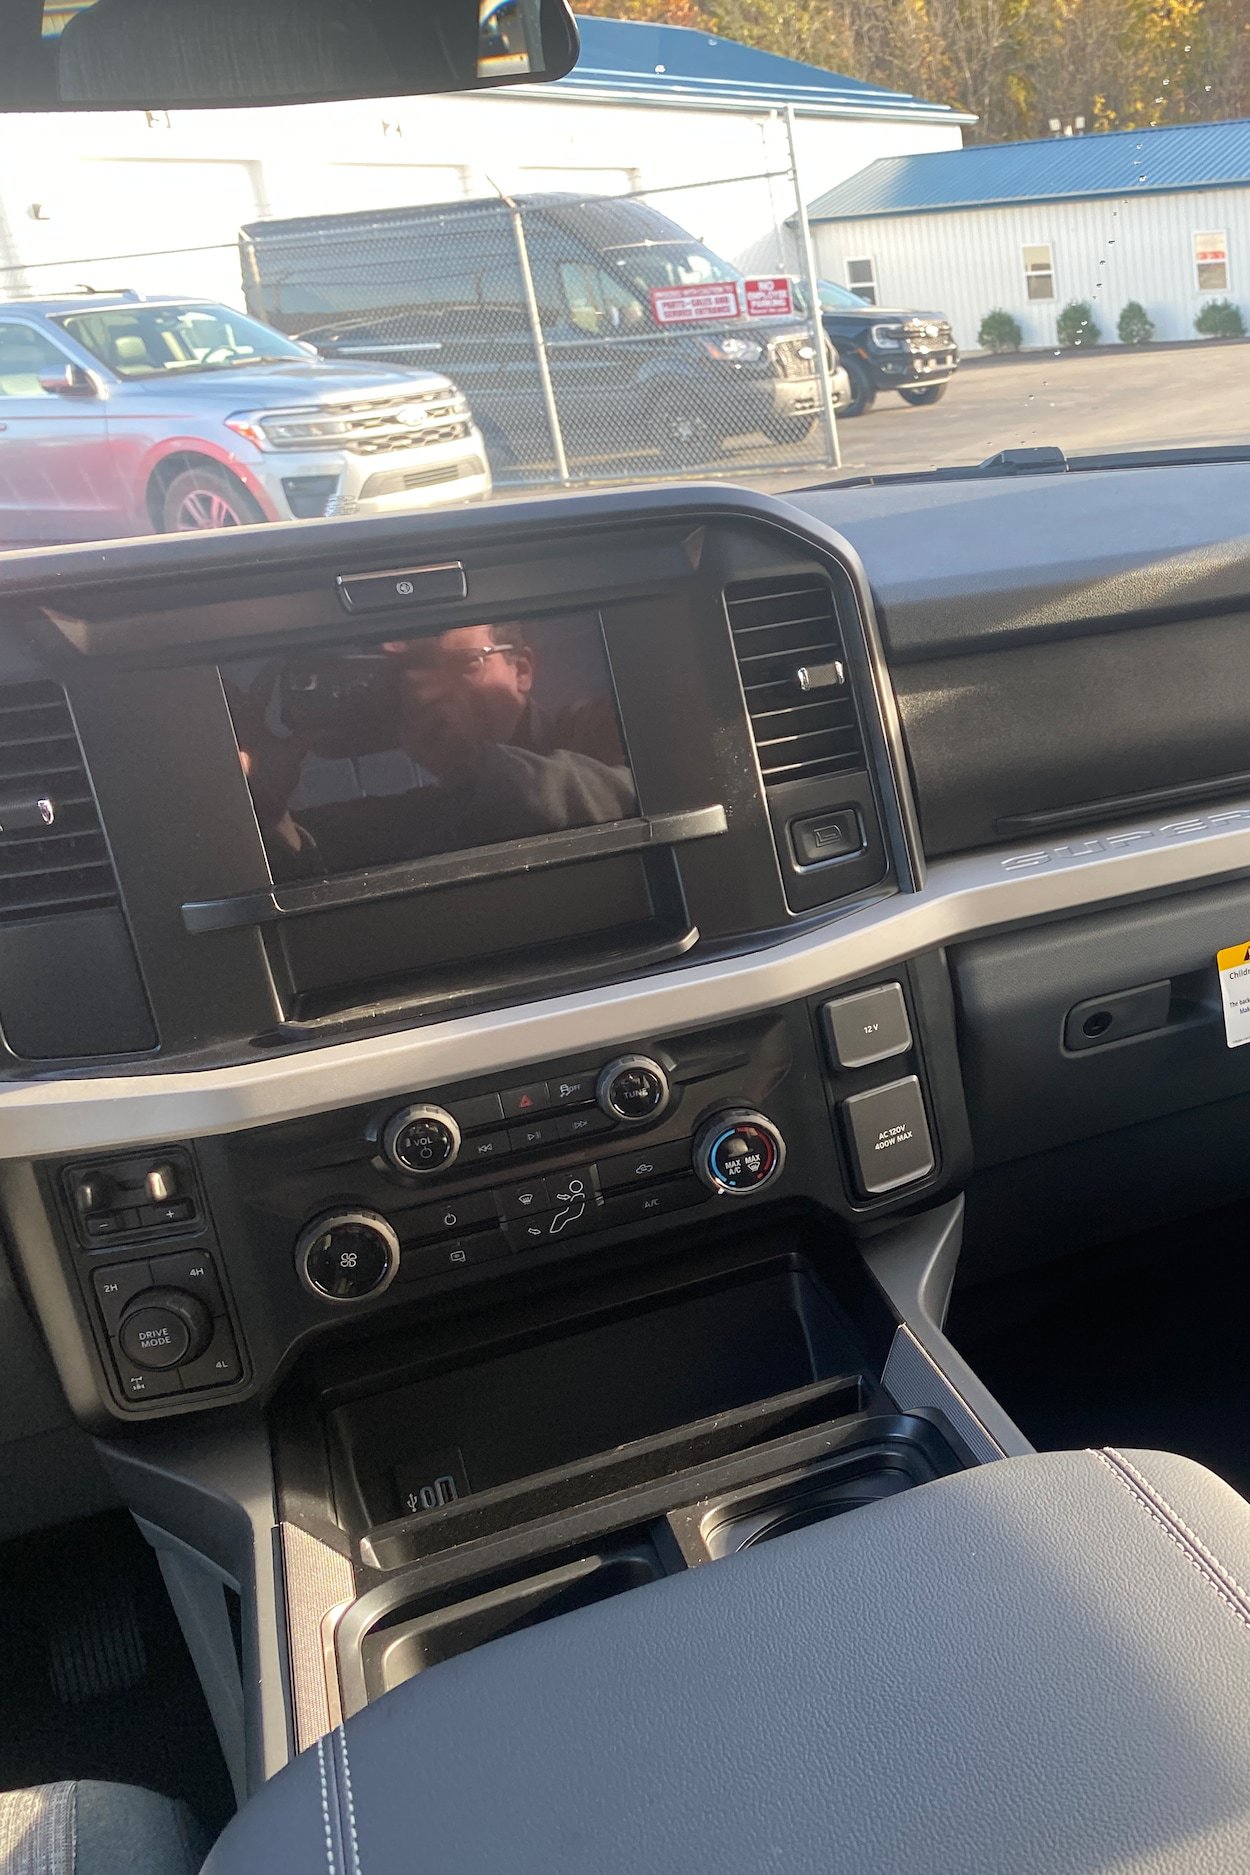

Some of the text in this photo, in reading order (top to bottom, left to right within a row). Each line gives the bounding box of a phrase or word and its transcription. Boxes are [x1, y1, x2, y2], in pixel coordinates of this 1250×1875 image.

[758, 281, 775, 291] NO
[1239, 998, 1250, 1006] back
[864, 1026, 872, 1034] 12
[623, 1087, 649, 1099] TUNE
[878, 1124, 906, 1140] AC 120V
[413, 1136, 433, 1147] VOL
[875, 1132, 913, 1150] 400W MAX
[744, 1154, 761, 1164] MAX
[725, 1159, 741, 1170] MAX
[729, 1166, 742, 1176] A/C
[644, 1198, 660, 1208] A/C
[189, 1267, 204, 1277] 4H
[103, 1283, 118, 1293] 2H
[138, 1327, 169, 1341] DRIVE
[140, 1335, 172, 1348] MODE
[215, 1360, 228, 1369] 4L
